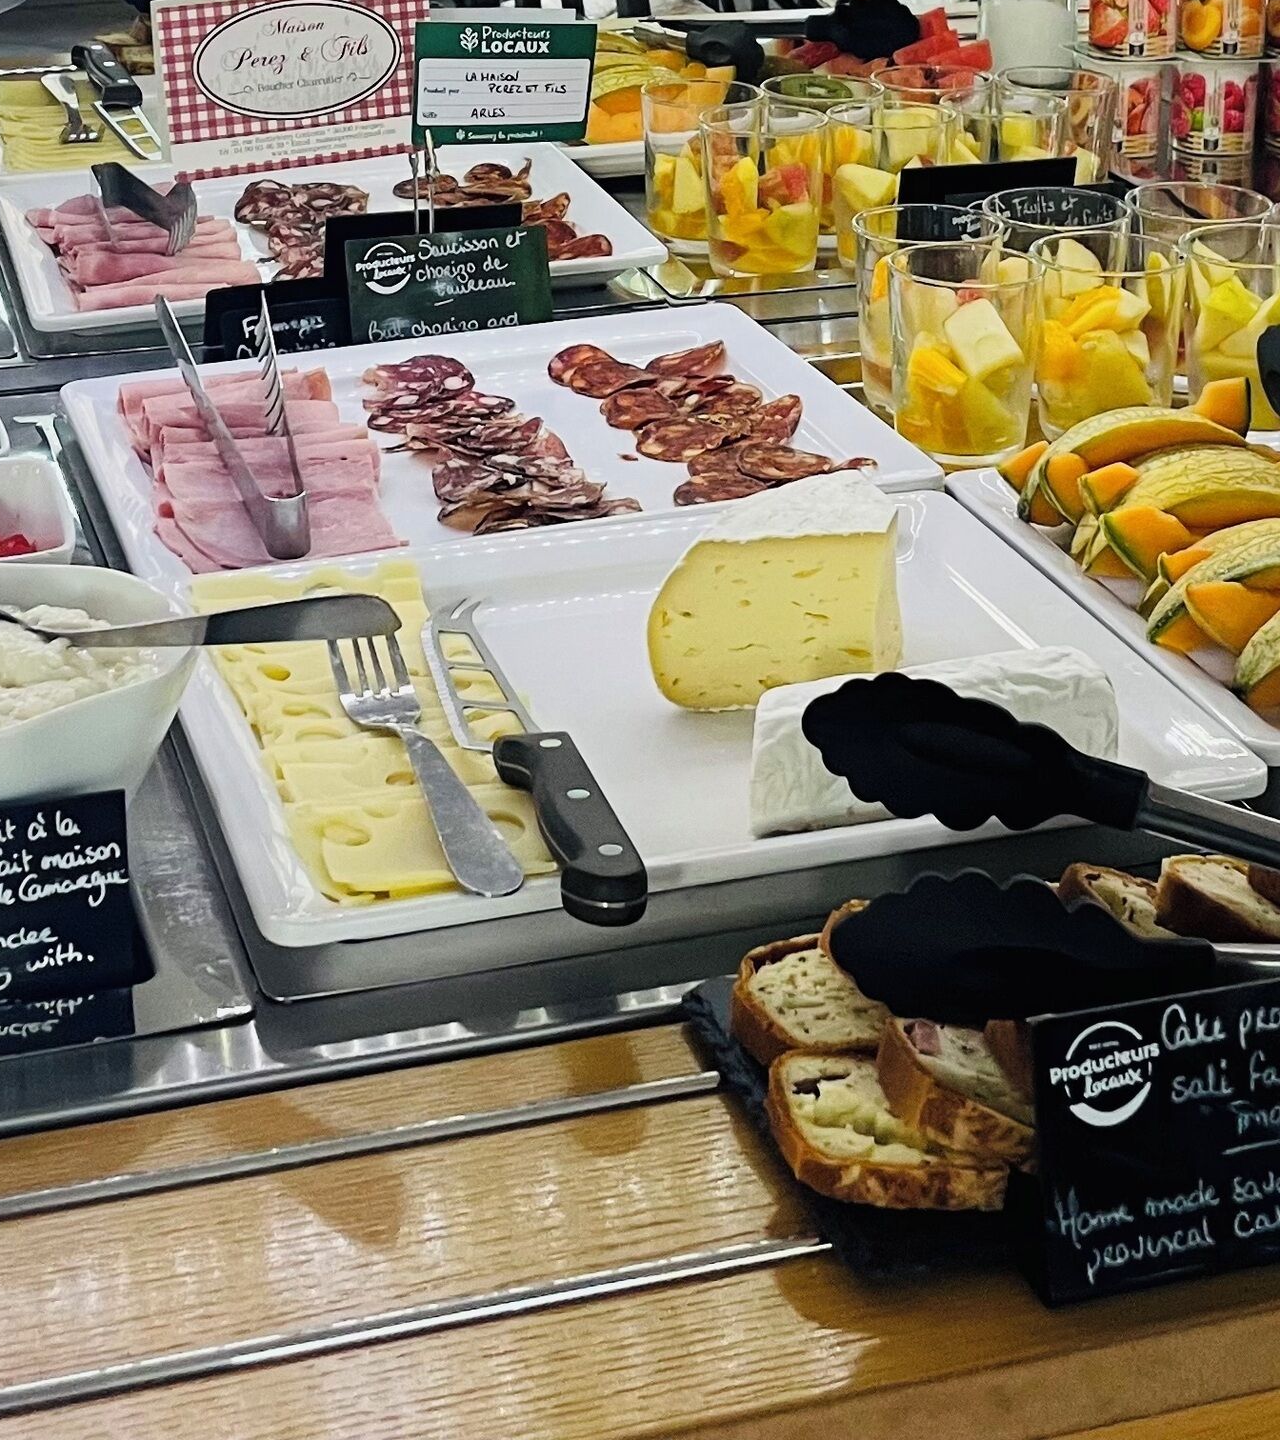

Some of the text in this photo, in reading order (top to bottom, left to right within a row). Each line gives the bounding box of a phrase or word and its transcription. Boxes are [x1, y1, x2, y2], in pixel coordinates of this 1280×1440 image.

[261, 17, 325, 37] Maison
[482, 26, 551, 40] Producteurs
[222, 46, 288, 75] Perez
[320, 32, 370, 62] Fils
[481, 40, 551, 54] LOCAUX
[470, 107, 506, 118] ARLES
[418, 230, 529, 260] Saucisson et
[355, 254, 416, 273] Producteurs
[483, 254, 510, 272] de
[55, 809, 81, 836] la
[39, 840, 121, 871] maison
[1160, 1003, 1226, 1052] Cake
[1049, 1042, 1160, 1085] Producteurs
[1144, 1179, 1221, 1215] made
